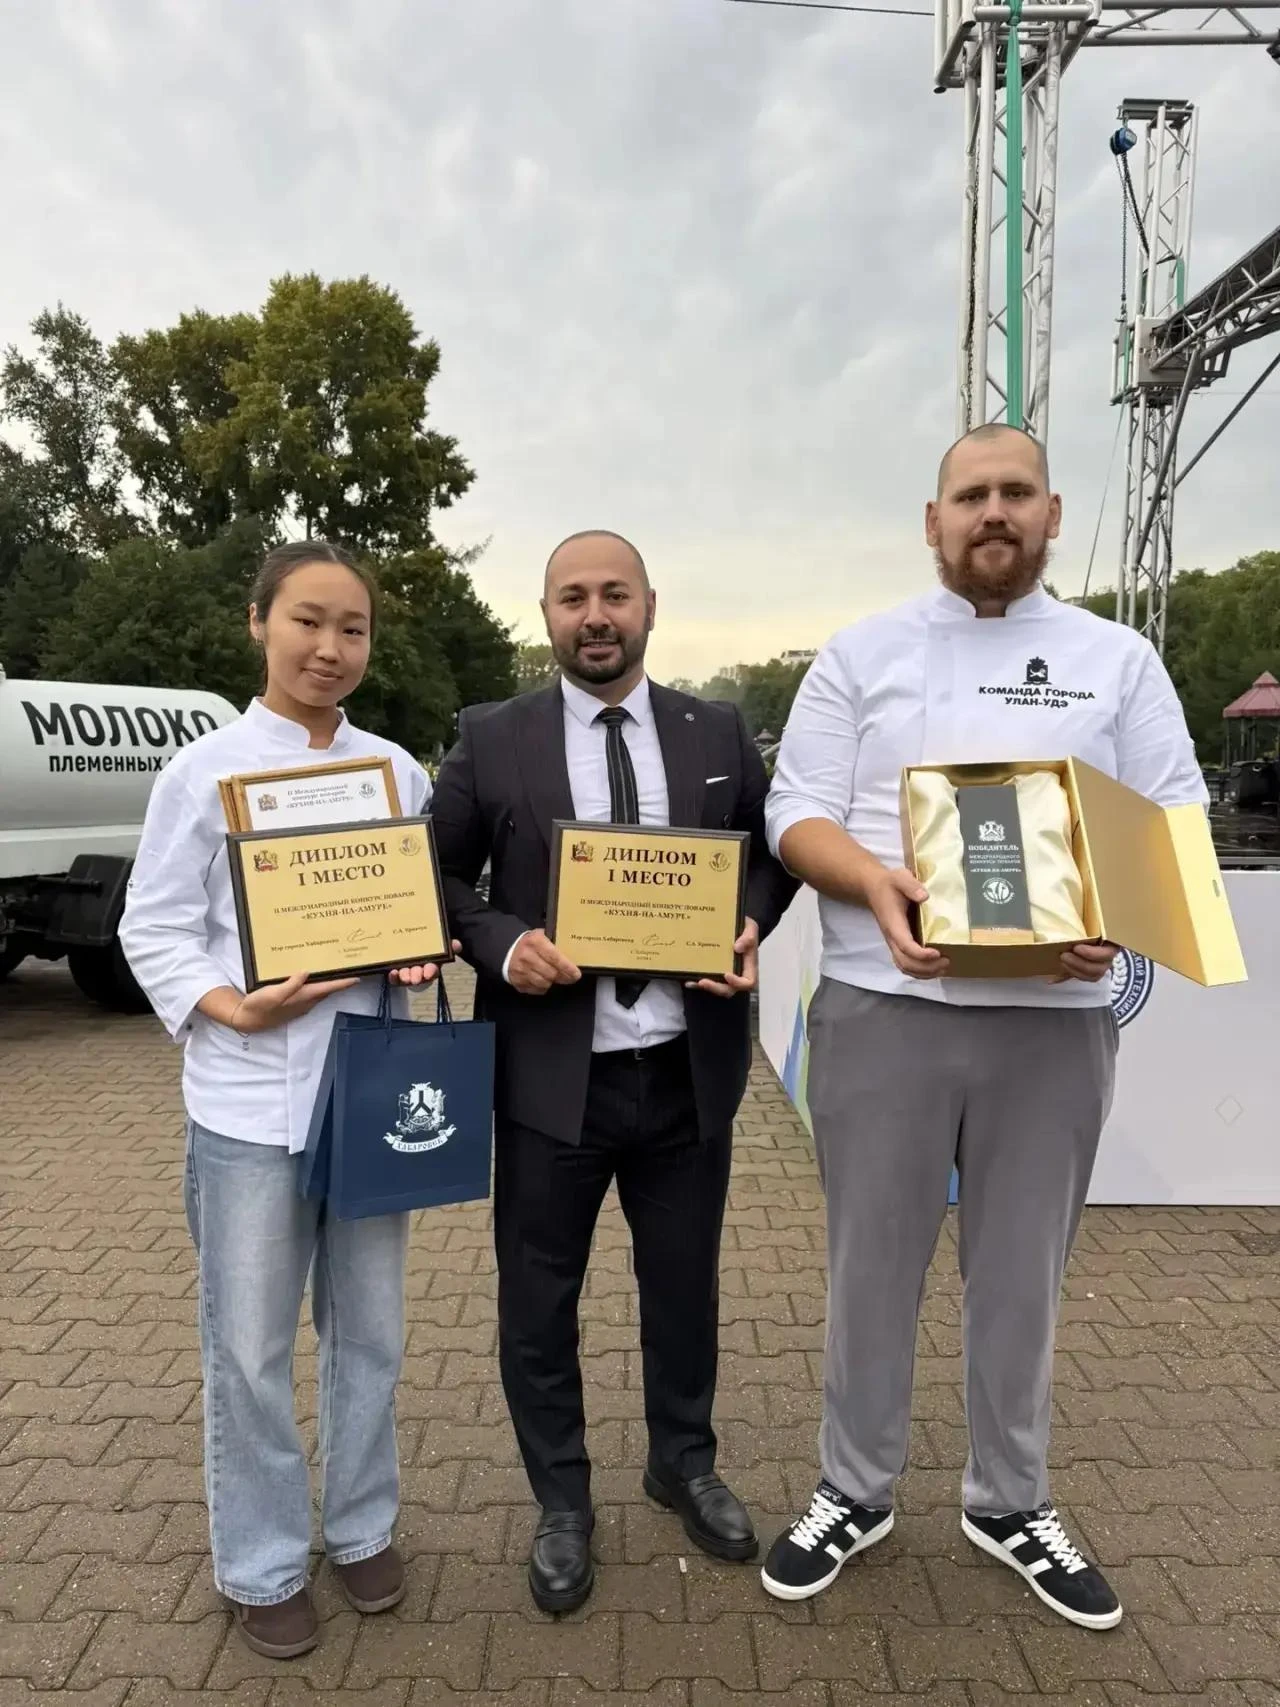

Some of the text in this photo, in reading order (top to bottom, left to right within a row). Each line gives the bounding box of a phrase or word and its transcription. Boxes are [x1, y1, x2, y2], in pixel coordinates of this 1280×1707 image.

[979, 686, 1095, 699] КОМАНДА ГОРОДА
[1005, 697, 1068, 708] УЛАН-УДЭ
[49, 755, 162, 772] племенных
[290, 842, 387, 867] ДИПЛОМ
[603, 847, 696, 865] ДИПЛОМ
[968, 844, 1019, 852] ПОБЕДИТЕЛЬ
[312, 863, 385, 884] МЕСТО
[622, 870, 691, 886] МЕСТО
